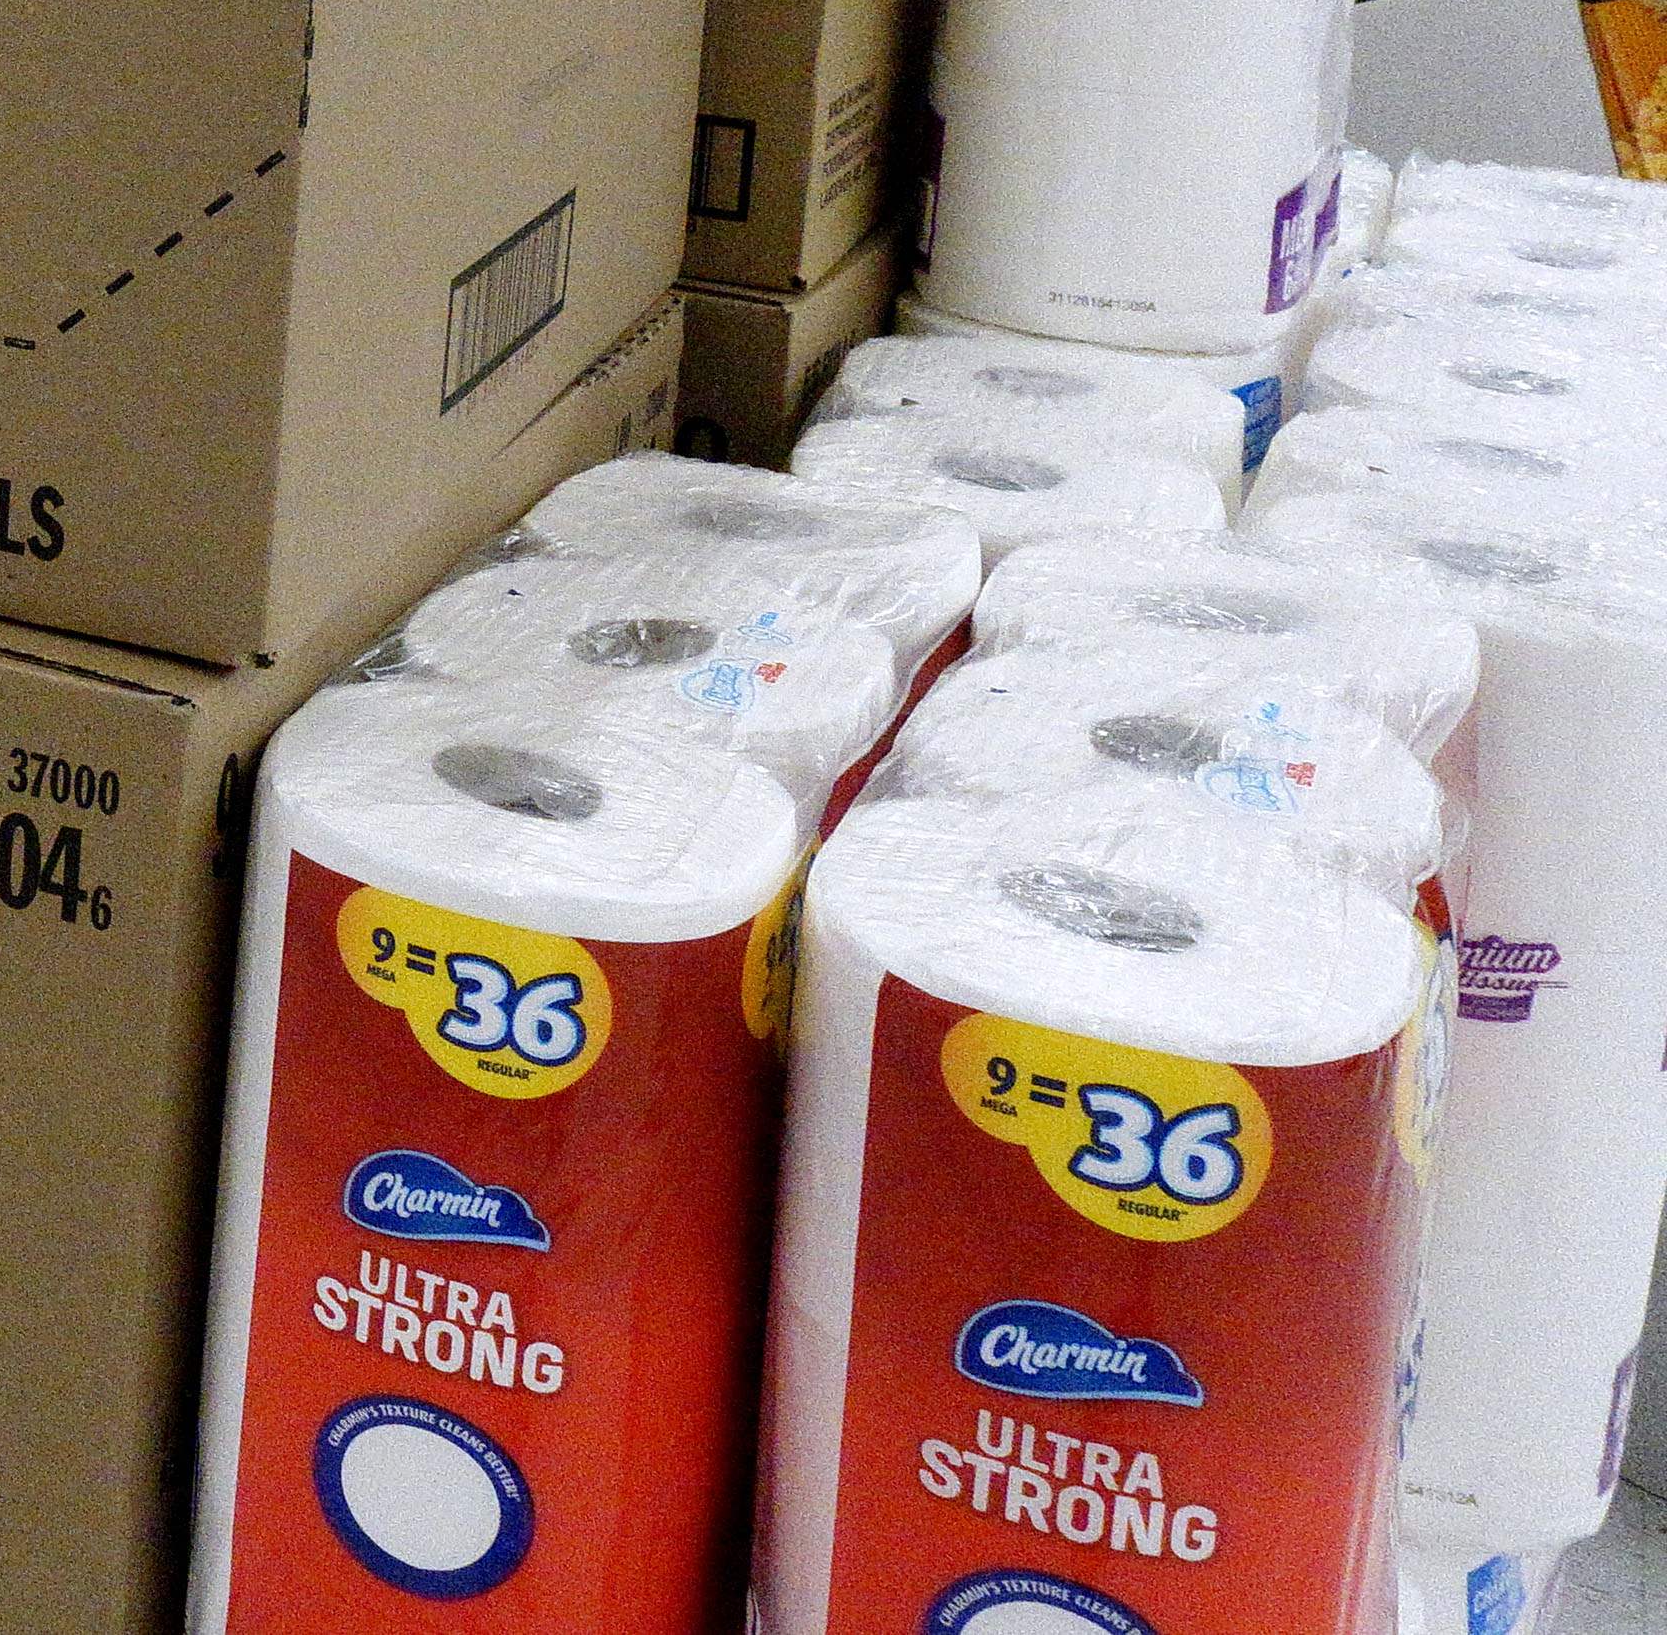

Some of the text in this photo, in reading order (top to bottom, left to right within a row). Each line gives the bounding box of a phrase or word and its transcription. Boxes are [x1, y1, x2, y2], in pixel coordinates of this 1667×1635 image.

[7, 747, 120, 817] 37000
[440, 953, 588, 1068] 36
[979, 1096, 1018, 1119] MEGA
[1069, 1083, 1245, 1206] 36
[361, 1169, 502, 1228] Charmin
[359, 1251, 517, 1333] ULTRA
[312, 1275, 566, 1396] STRONG
[977, 1323, 1149, 1385] Charmin
[378, 1404, 437, 1424] TEXTURE
[438, 1418, 487, 1453] CLEANS
[976, 1409, 1166, 1500] ULTRA
[918, 1438, 1218, 1564] STRONG
[939, 1580, 1132, 1630] CHARMIN'S TEXTURE CLEANS
